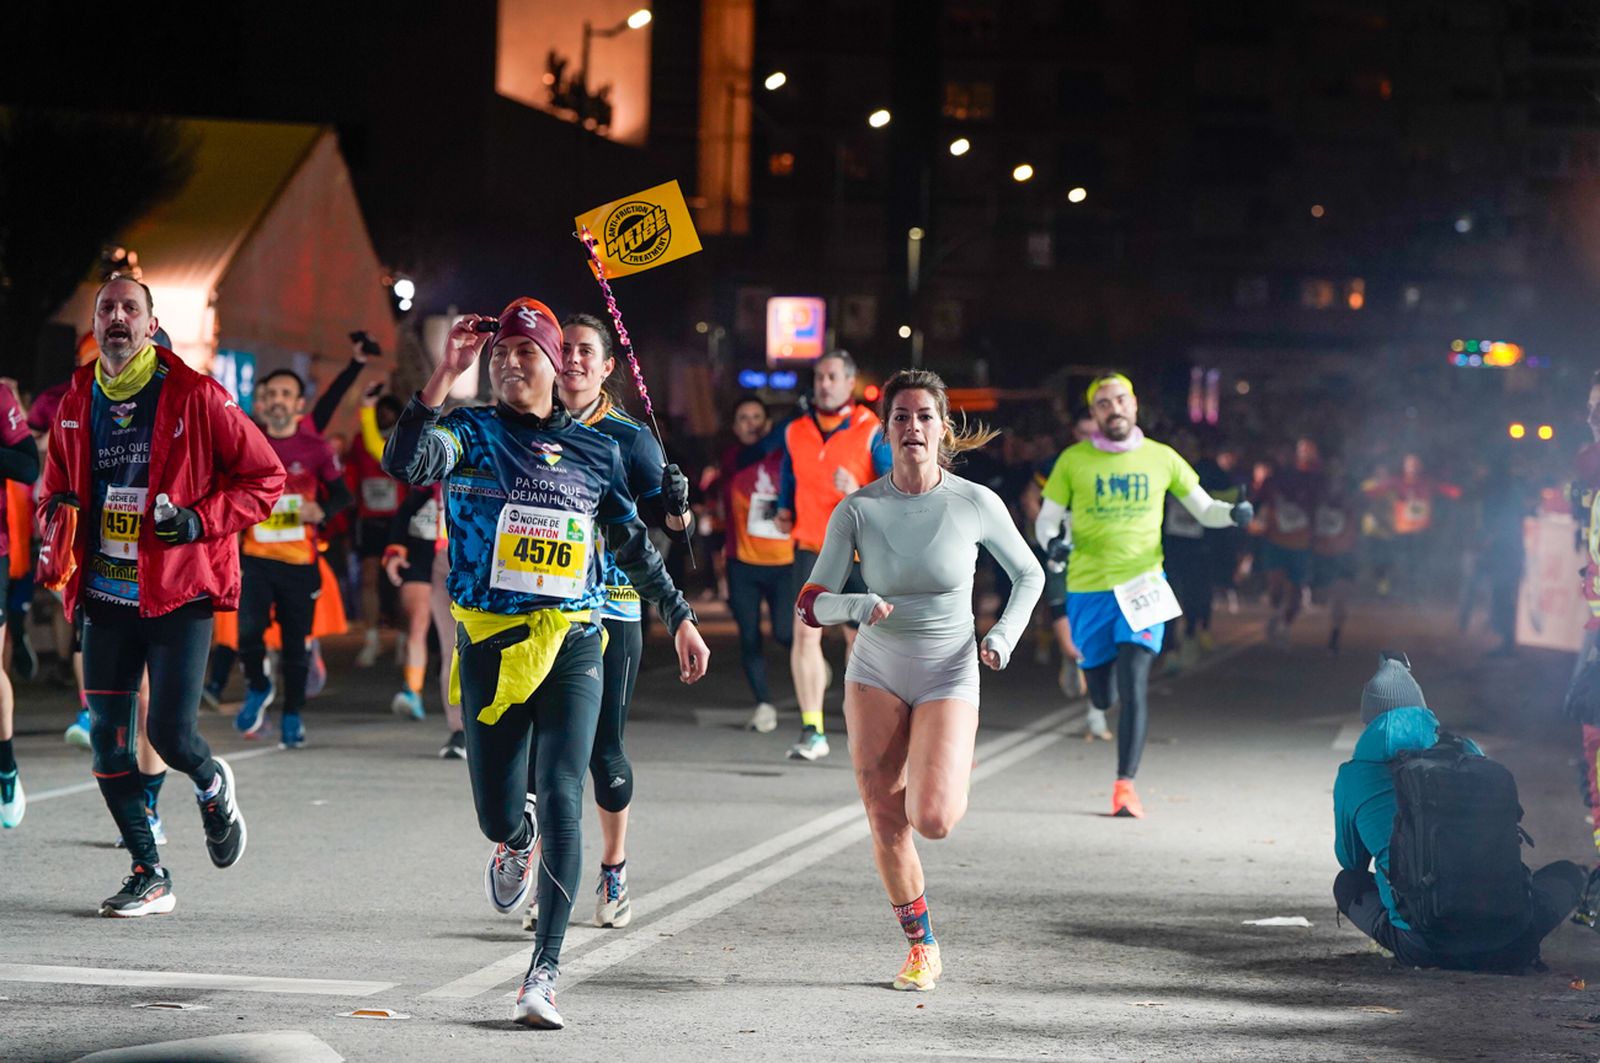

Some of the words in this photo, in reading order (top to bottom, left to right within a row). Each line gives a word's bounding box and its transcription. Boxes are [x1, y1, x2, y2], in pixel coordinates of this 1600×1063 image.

[607, 205, 664, 258] METAL
[608, 204, 649, 238] ANTI-FRICTION
[618, 216, 668, 263] LUBE
[628, 236, 668, 263] TREATMENT
[128, 442, 149, 453] QUE
[511, 490, 548, 503] DEJAN
[515, 477, 555, 492] PASOS
[559, 483, 582, 498] QUE
[507, 524, 527, 535] SAN
[528, 527, 559, 539] ANTÓN
[520, 515, 548, 527] NOCHE
[549, 519, 560, 528] DE
[513, 537, 572, 567] 4576
